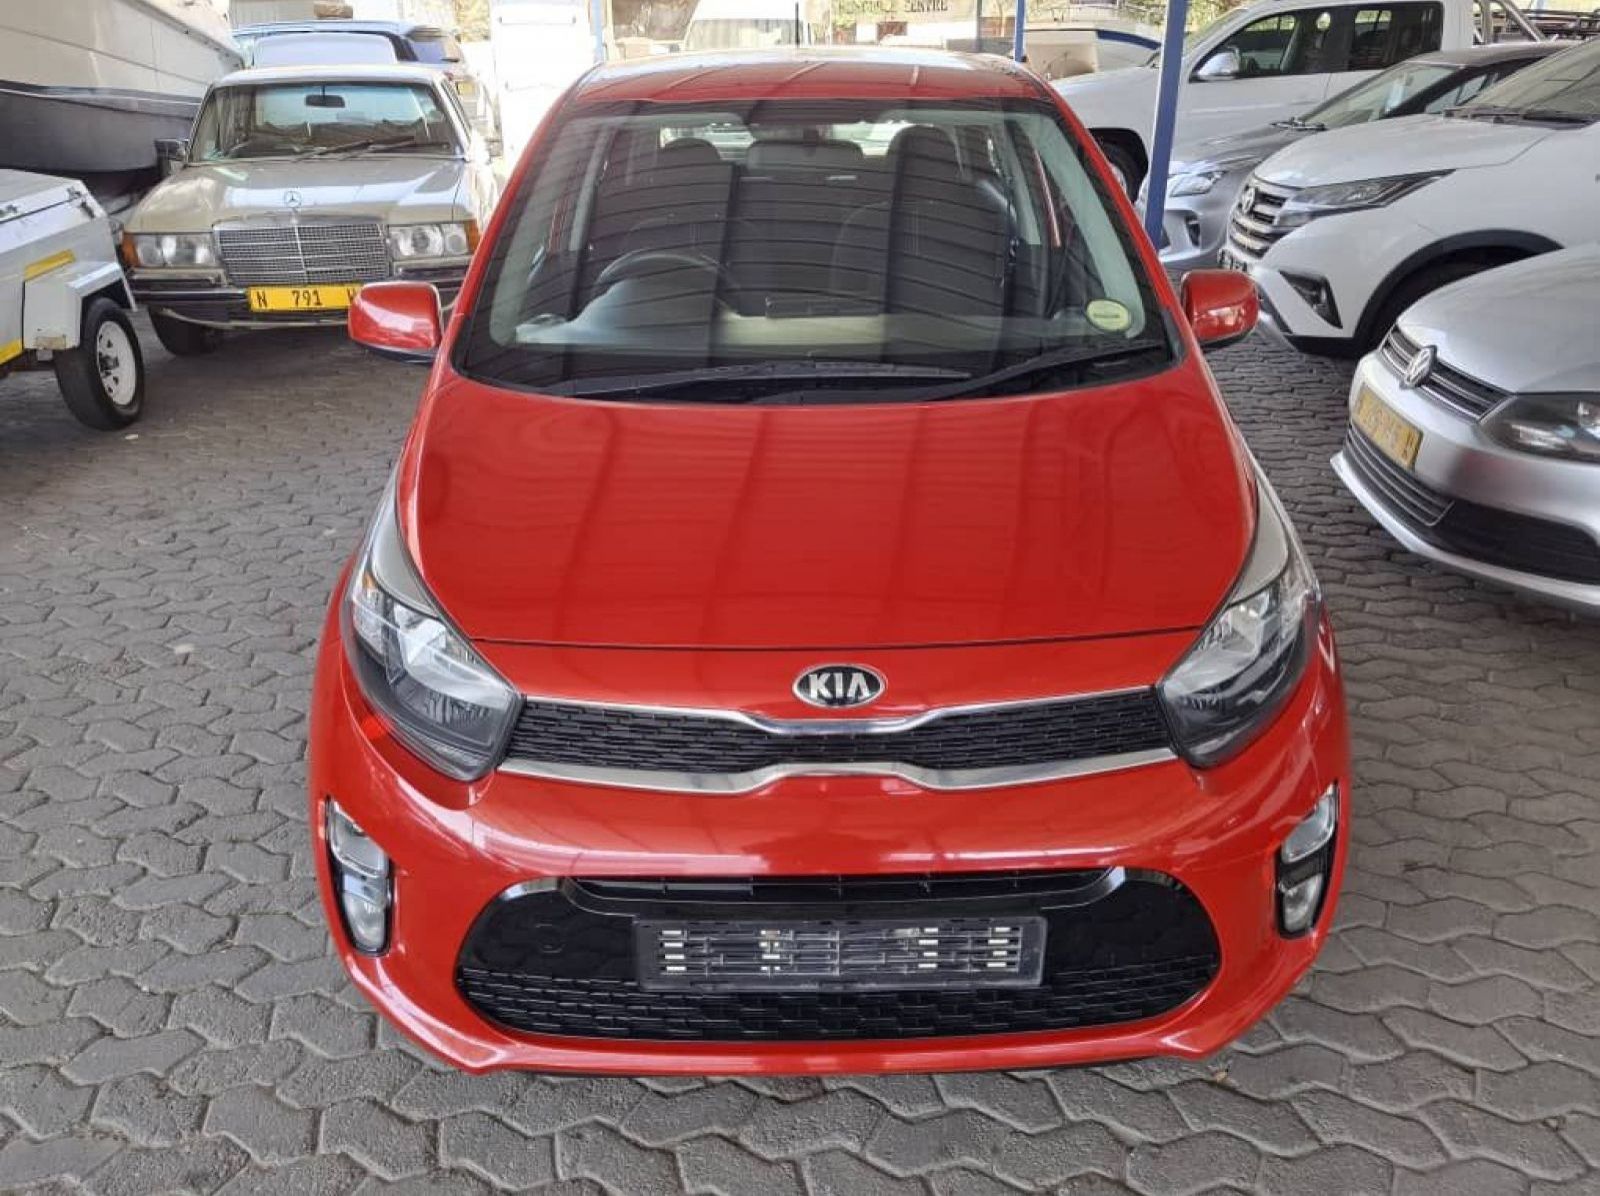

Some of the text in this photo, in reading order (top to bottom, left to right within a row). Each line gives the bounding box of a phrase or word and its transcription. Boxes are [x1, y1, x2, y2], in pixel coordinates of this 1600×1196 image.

[256, 290, 268, 308] N
[292, 289, 323, 307] 791
[808, 672, 870, 700] KIA
